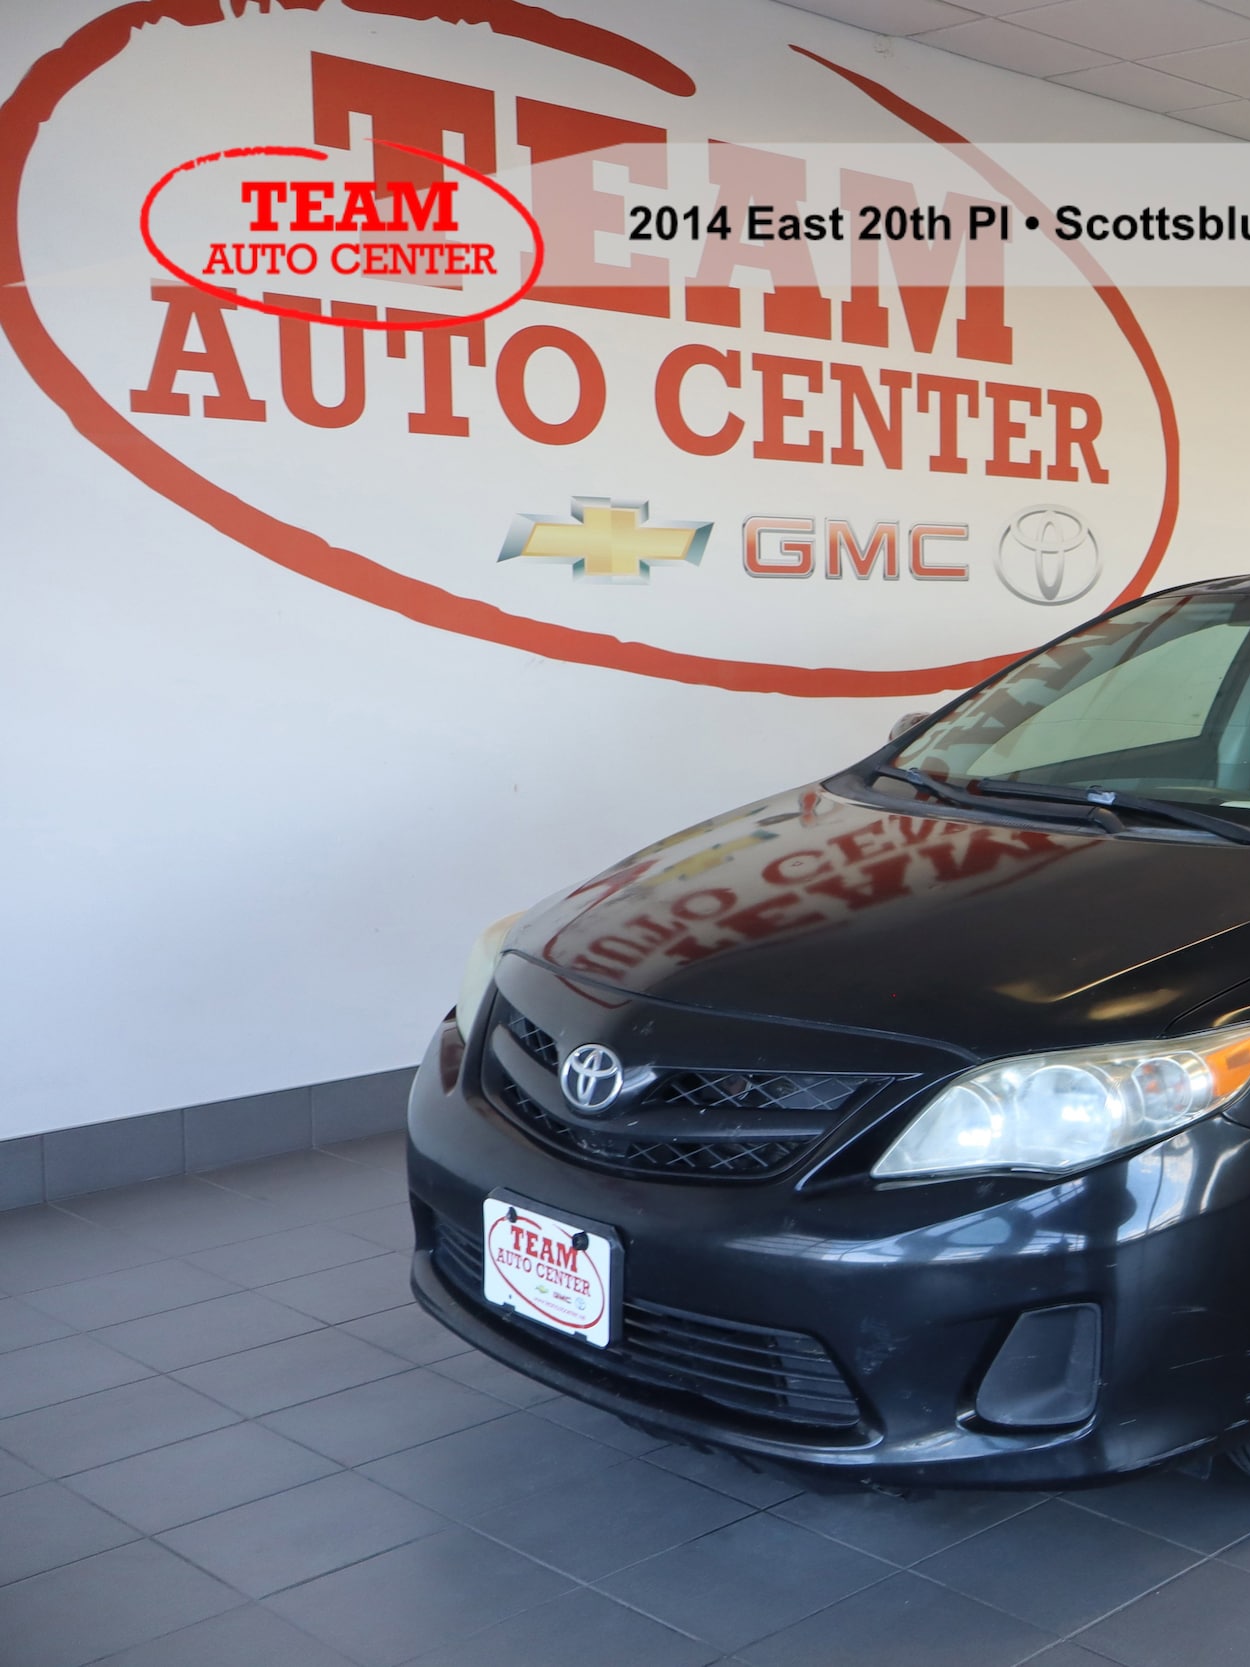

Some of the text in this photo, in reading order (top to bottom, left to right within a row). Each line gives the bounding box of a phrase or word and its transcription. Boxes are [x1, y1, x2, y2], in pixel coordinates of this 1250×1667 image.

[310, 50, 1014, 365] TEAM
[129, 277, 1110, 485] AUTO CENTER
[741, 513, 970, 582] GMC
[496, 1247, 592, 1297] AUTO CENTER
[510, 1224, 579, 1274] TEAM
